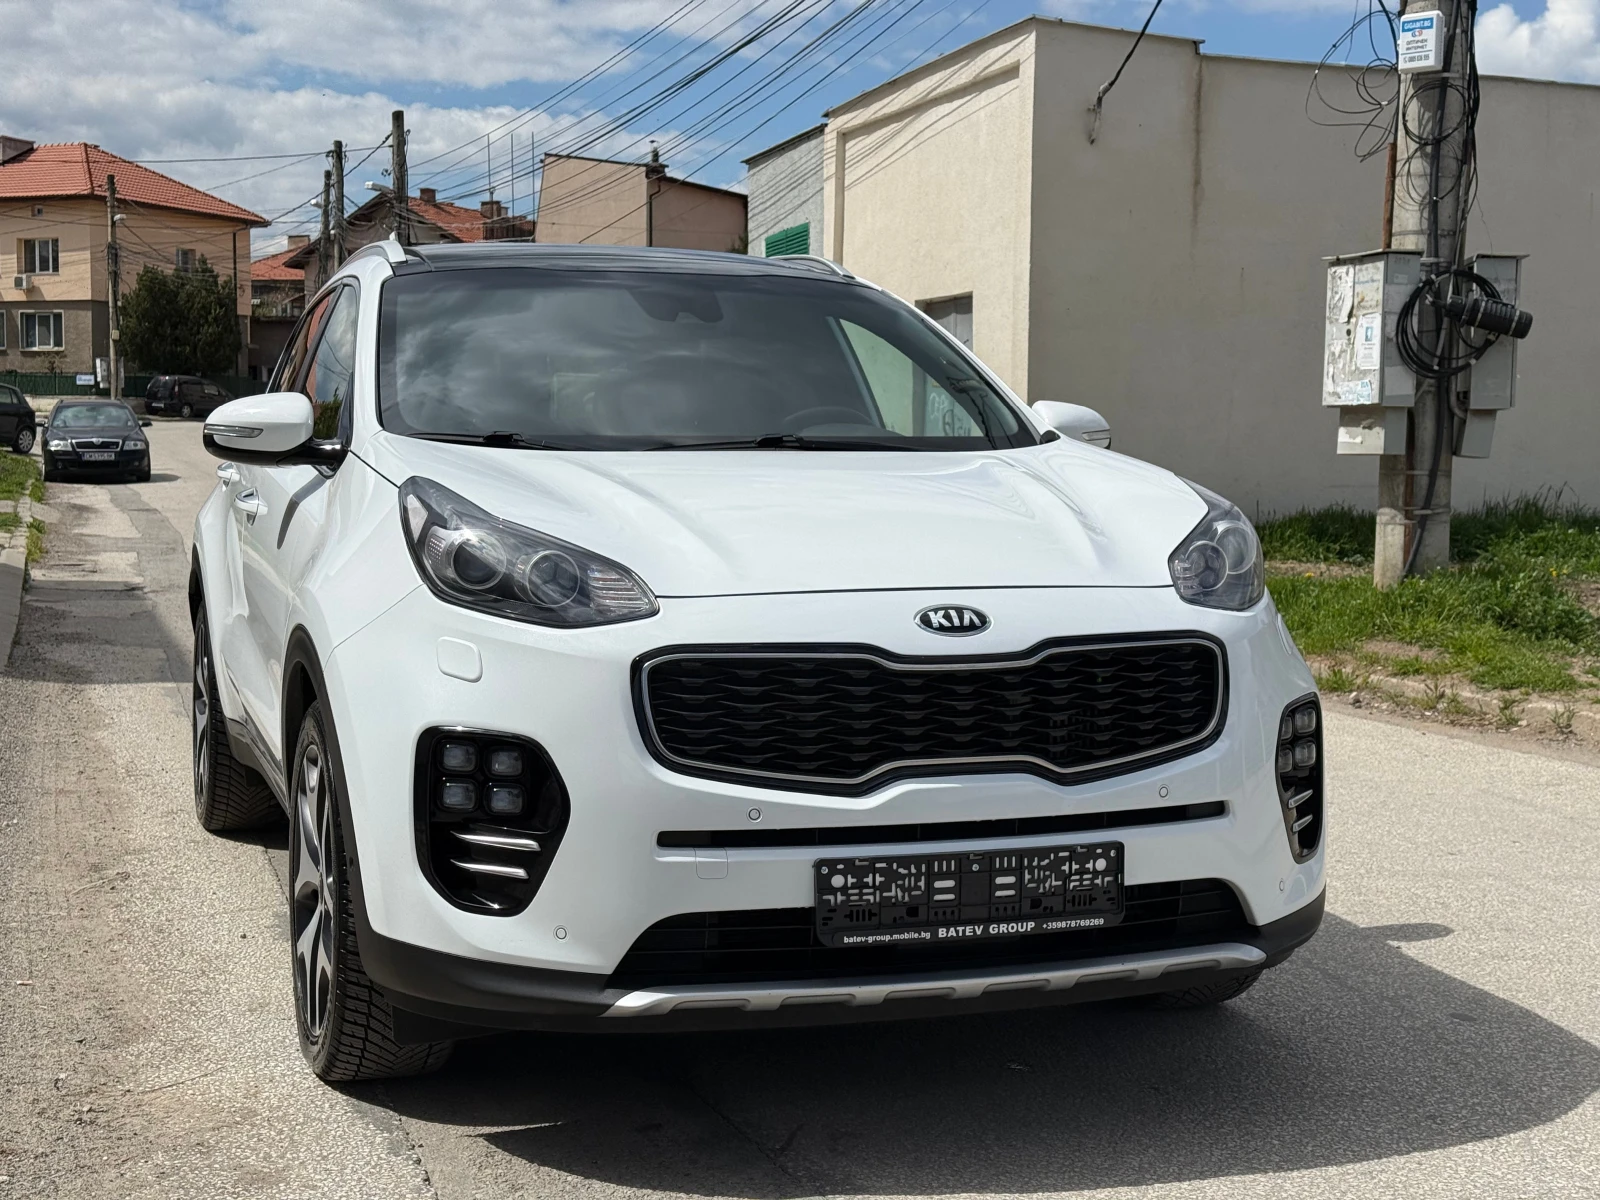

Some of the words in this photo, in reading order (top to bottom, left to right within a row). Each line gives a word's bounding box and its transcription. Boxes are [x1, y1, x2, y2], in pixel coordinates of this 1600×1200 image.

[927, 609, 982, 628] KIA
[843, 930, 931, 944] batev-group.mobile.bg
[938, 924, 984, 938] BATEV
[988, 921, 1036, 935] GROUP
[1041, 917, 1105, 930] +359878769269
